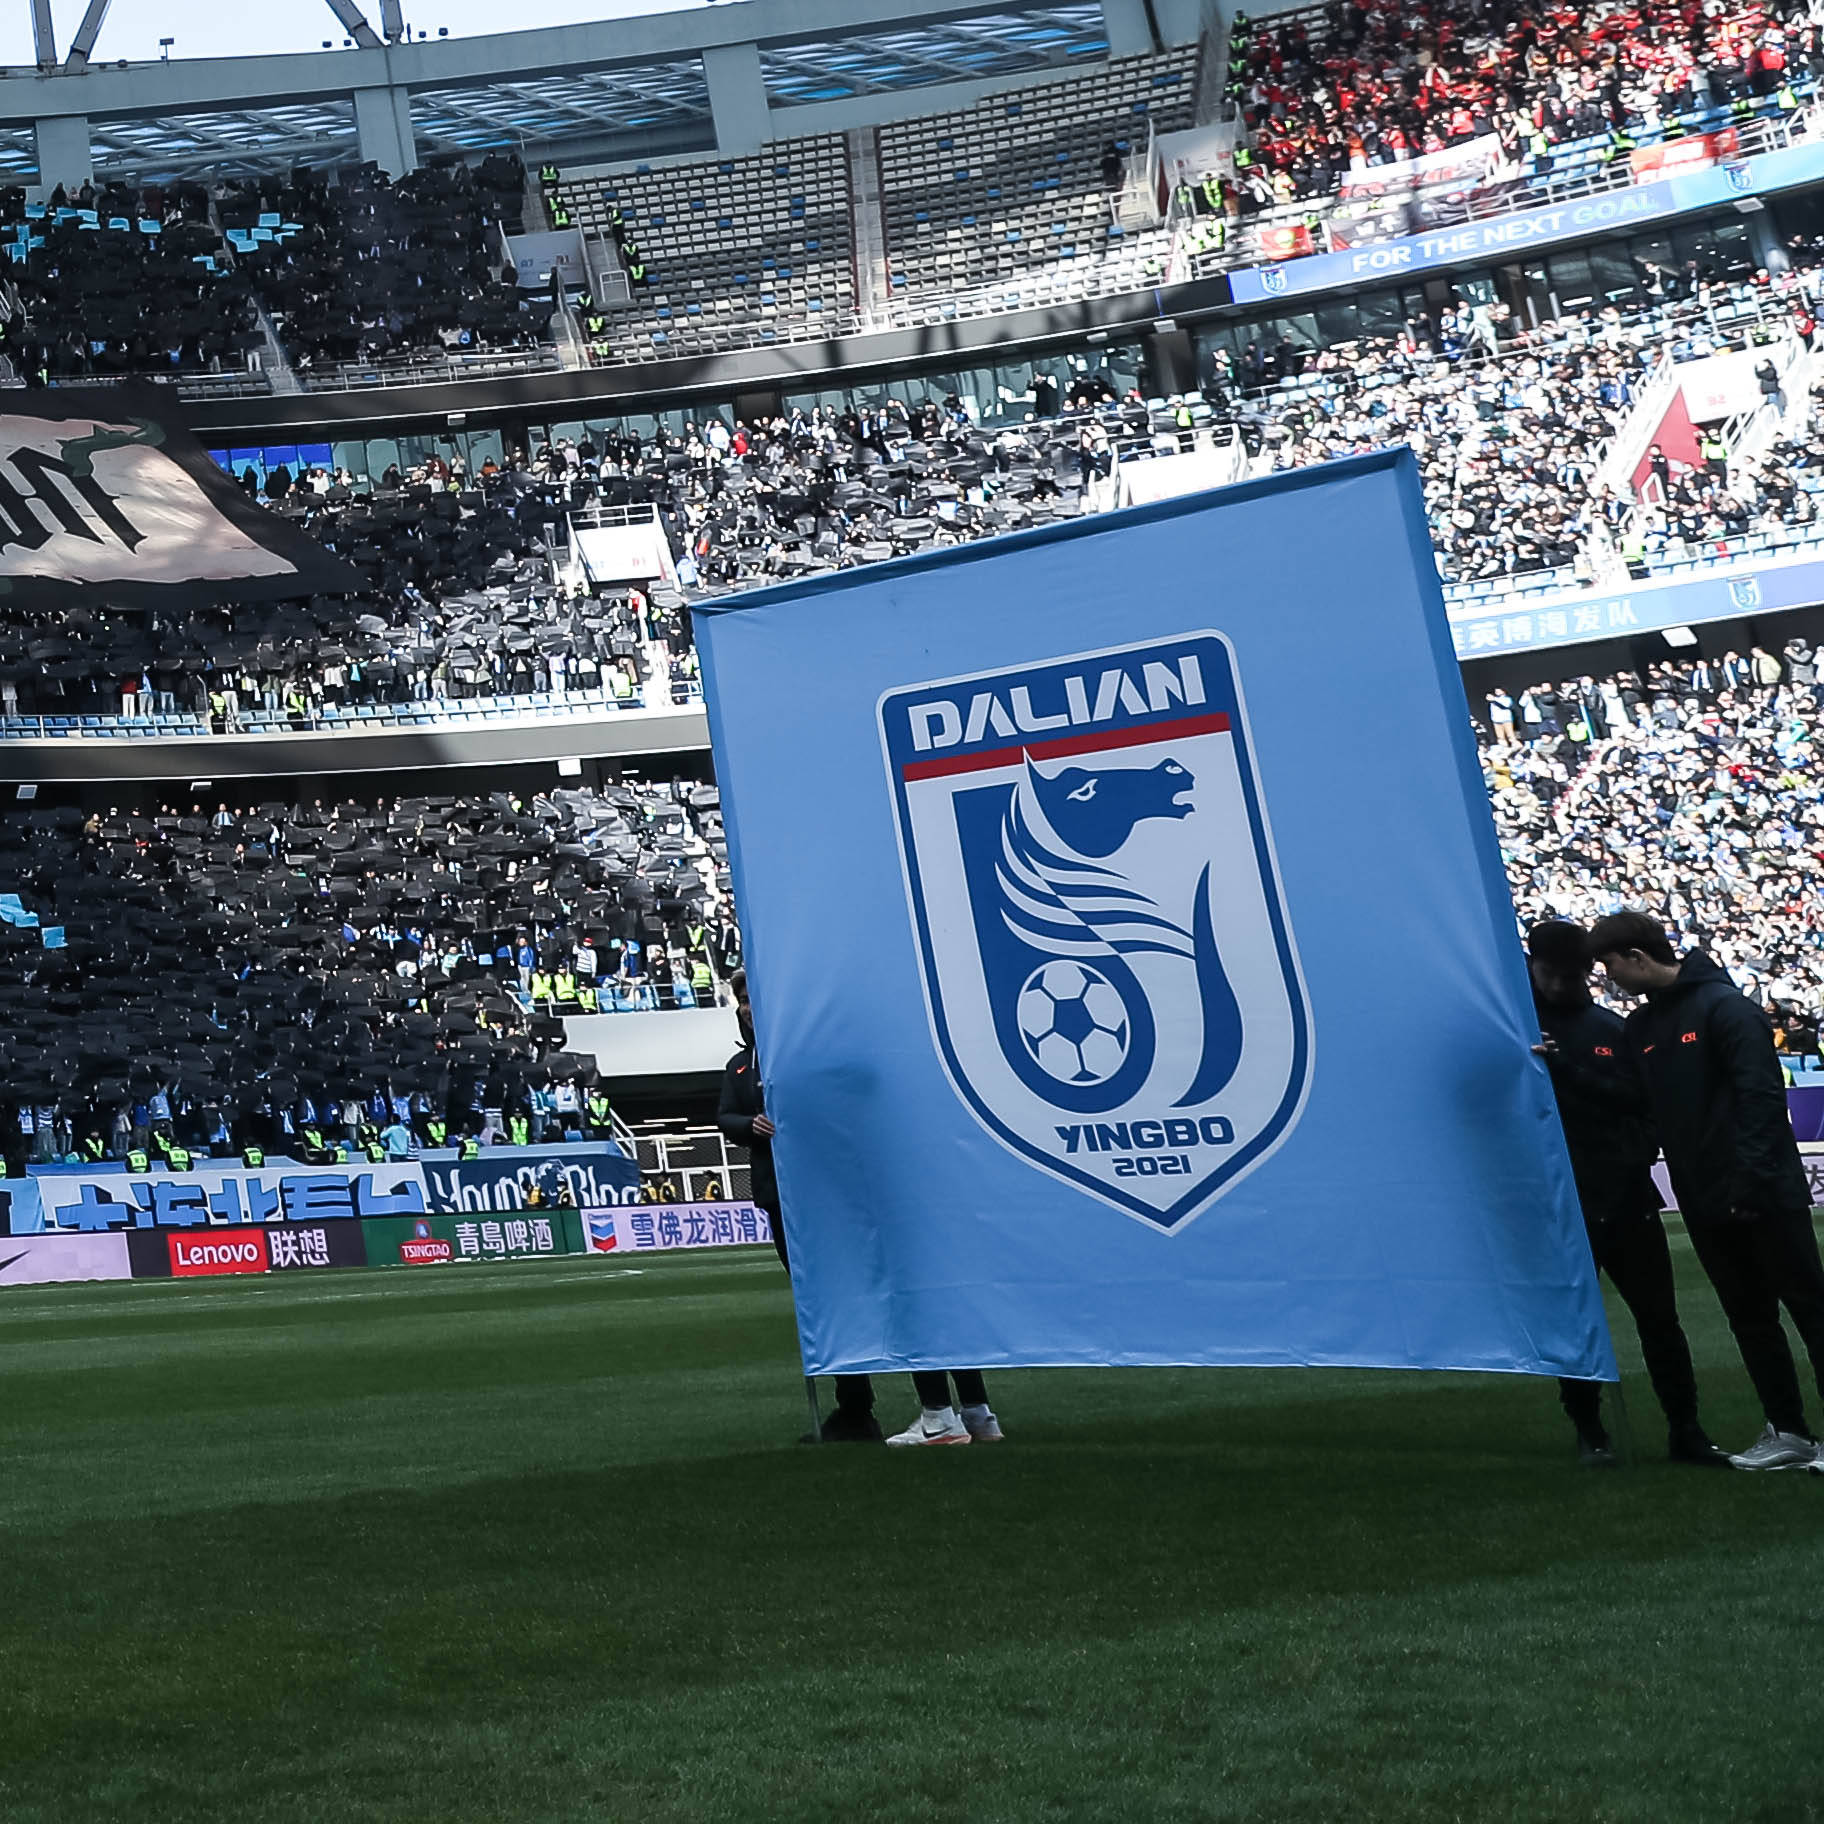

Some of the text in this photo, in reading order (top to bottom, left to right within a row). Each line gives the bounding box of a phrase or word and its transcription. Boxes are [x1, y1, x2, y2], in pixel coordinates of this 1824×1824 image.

[1353, 192, 1658, 273] FOR THE NEXT GOAL
[908, 655, 1207, 752] DALIAN
[1055, 1114, 1236, 1155] YINGBO
[1113, 1154, 1192, 1178] 2021
[176, 1242, 258, 1267] Lenovo
[268, 1228, 331, 1267] 联想
[401, 1243, 450, 1259] TSINGTAO
